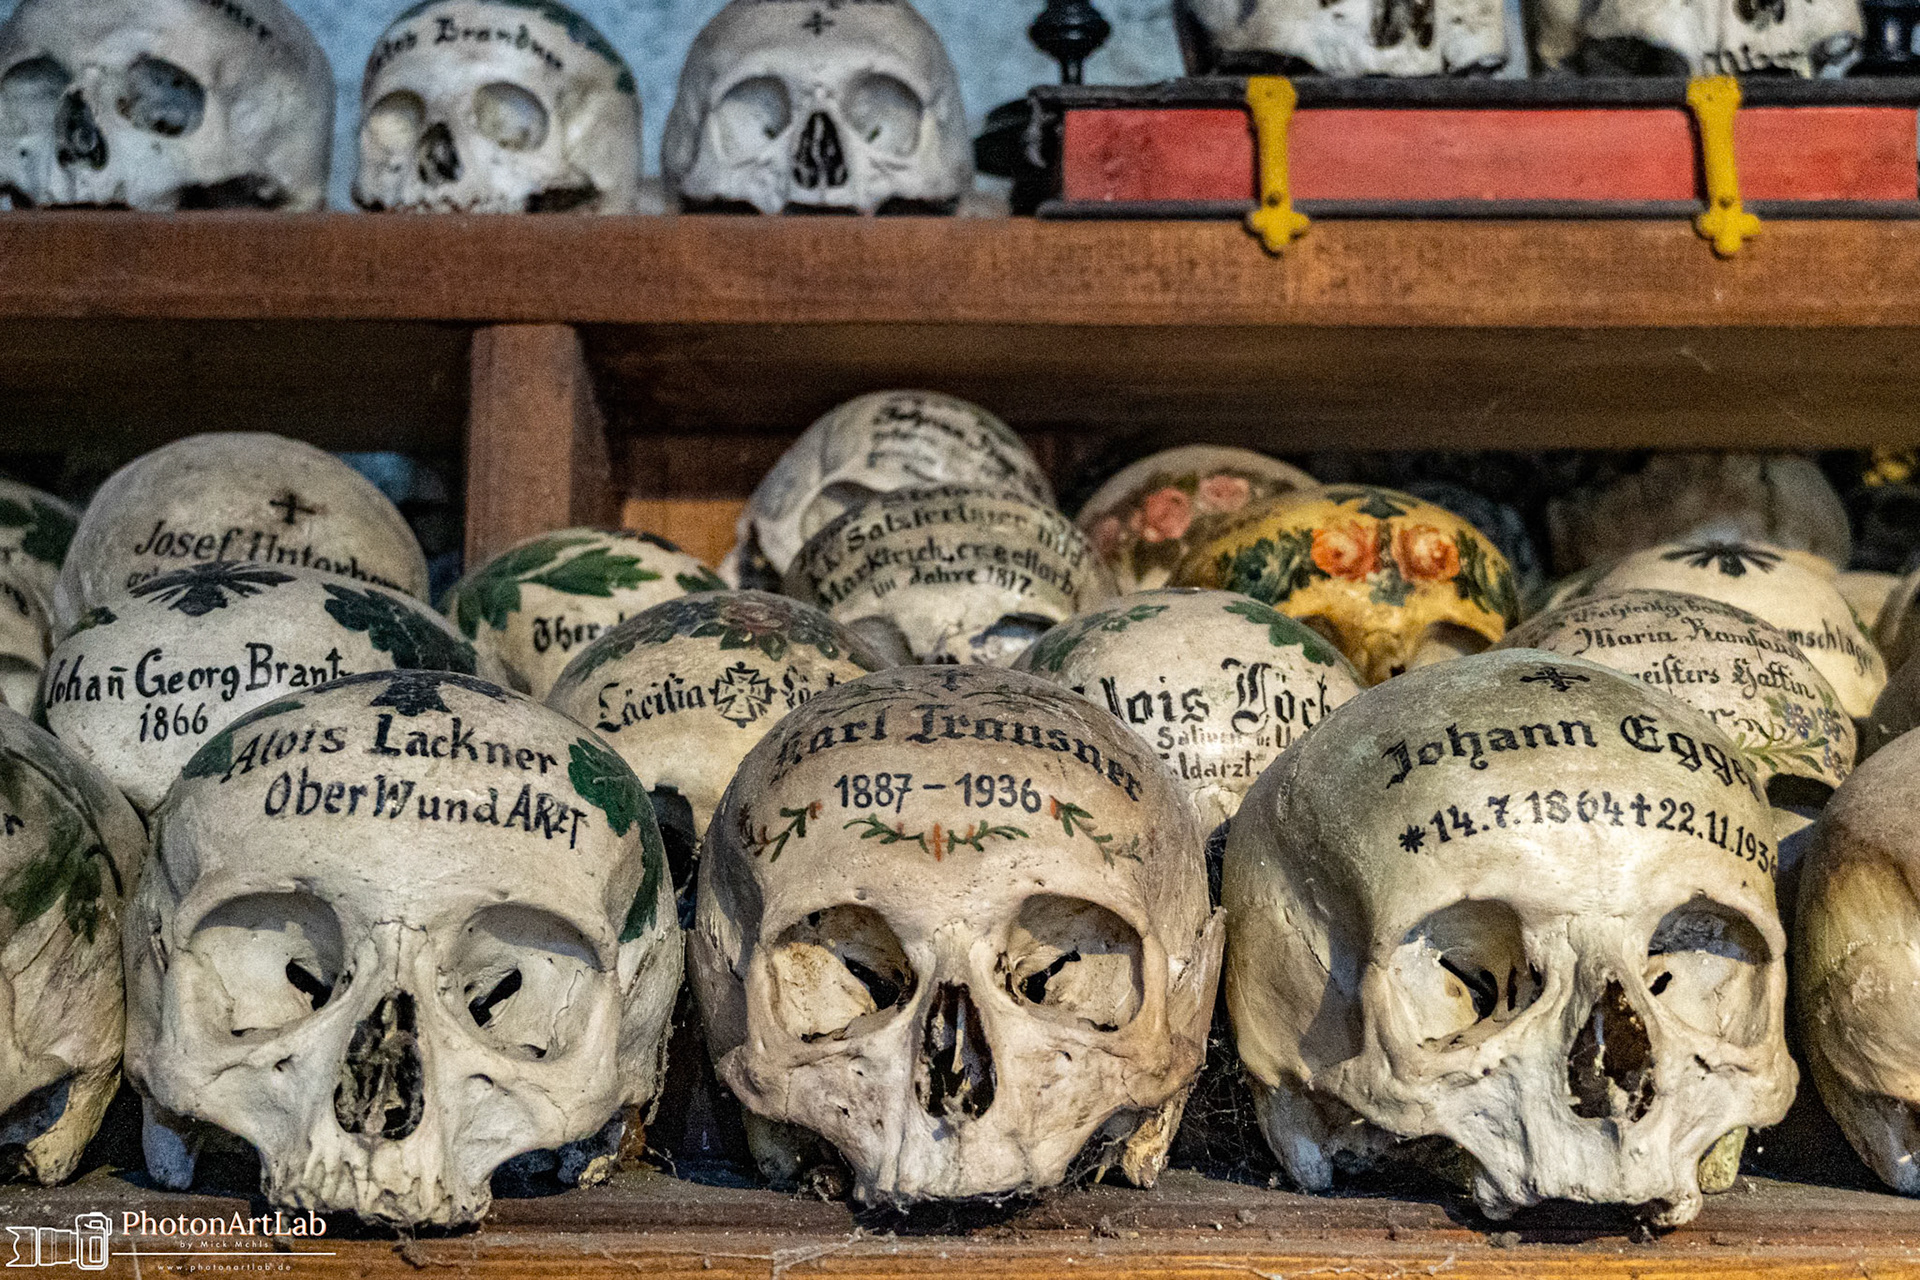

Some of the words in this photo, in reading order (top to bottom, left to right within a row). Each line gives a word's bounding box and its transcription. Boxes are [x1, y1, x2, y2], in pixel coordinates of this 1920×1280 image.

[134, 519, 243, 561] Josef
[1573, 623, 1679, 657] Maria
[134, 648, 241, 701] Georg
[245, 641, 354, 692] Brant
[138, 702, 209, 742] 1866
[1072, 674, 1210, 724] lois
[220, 723, 350, 784] Alois
[361, 713, 559, 778] Lackner
[1381, 720, 1599, 789] Johann
